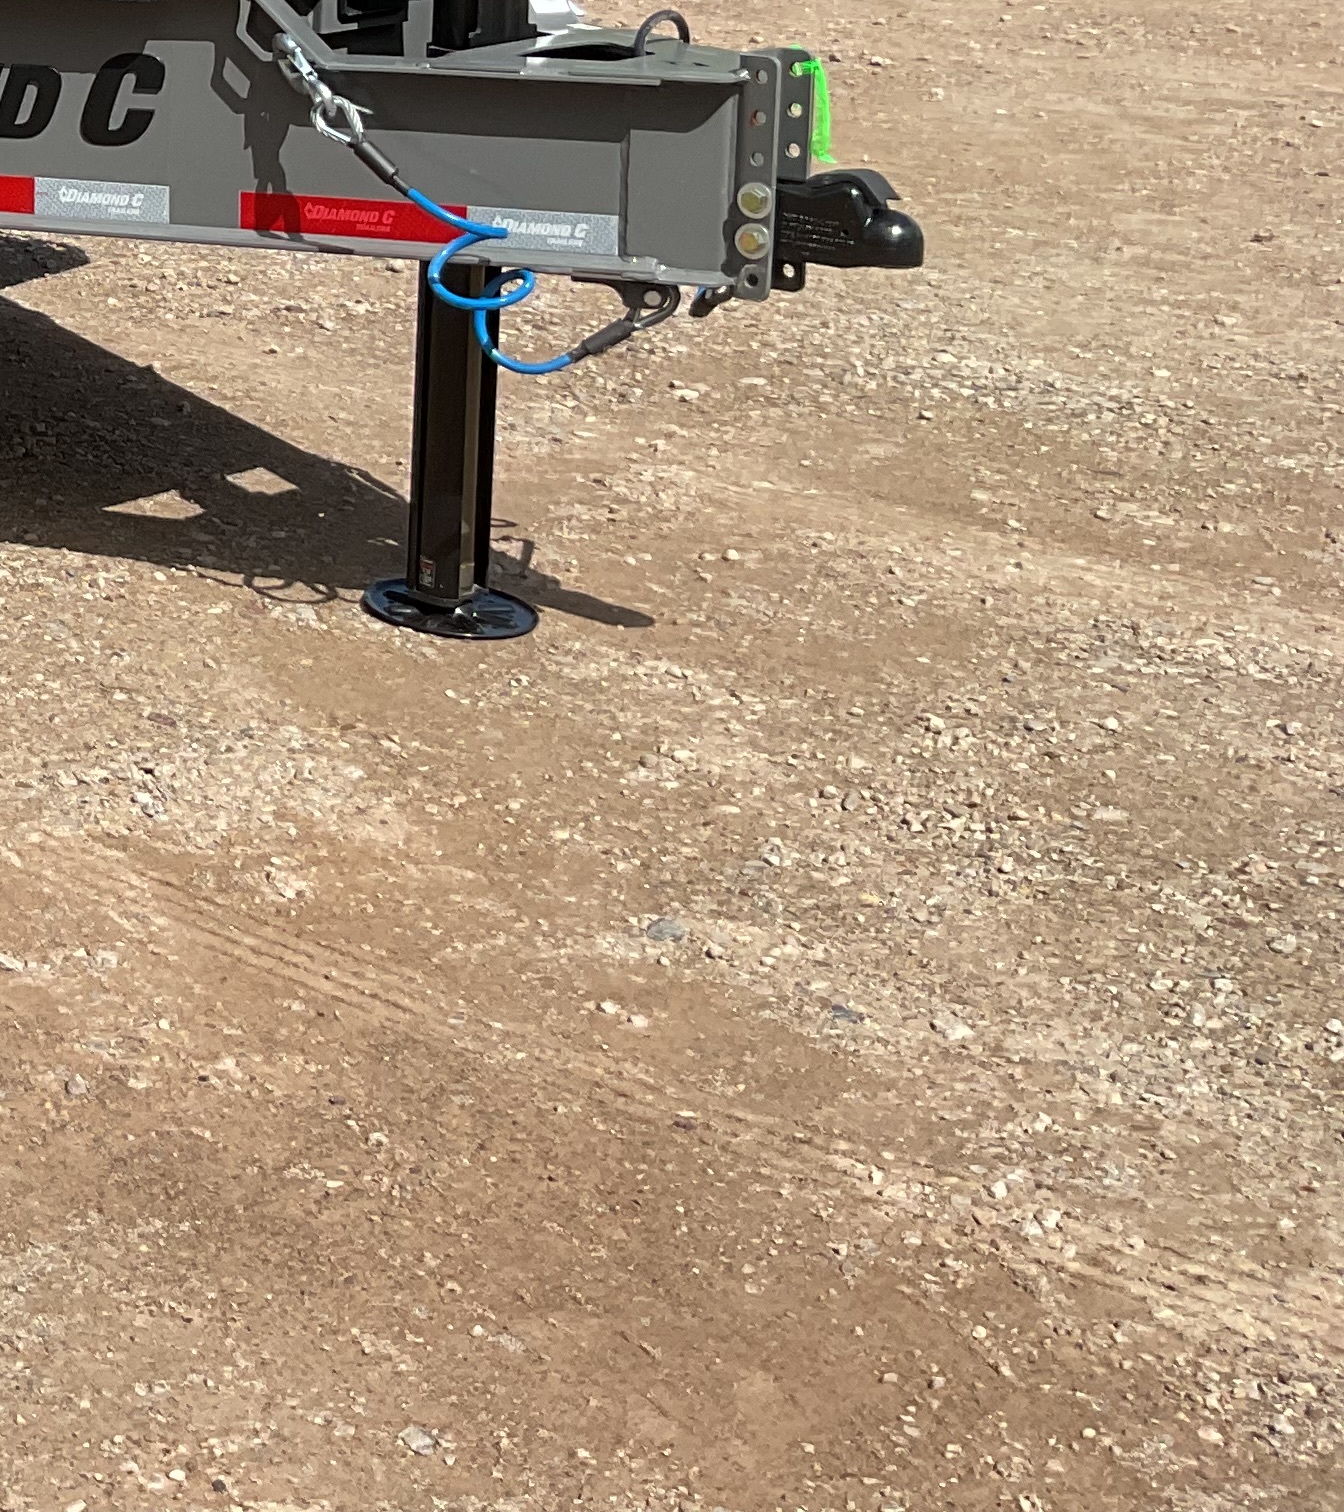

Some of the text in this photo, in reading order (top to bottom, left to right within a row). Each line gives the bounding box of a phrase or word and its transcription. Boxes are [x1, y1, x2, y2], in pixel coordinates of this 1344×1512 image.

[79, 52, 166, 147] C
[66, 187, 145, 207] DIAMOND C
[312, 205, 396, 225] DIAMOND C
[573, 223, 589, 239] C
